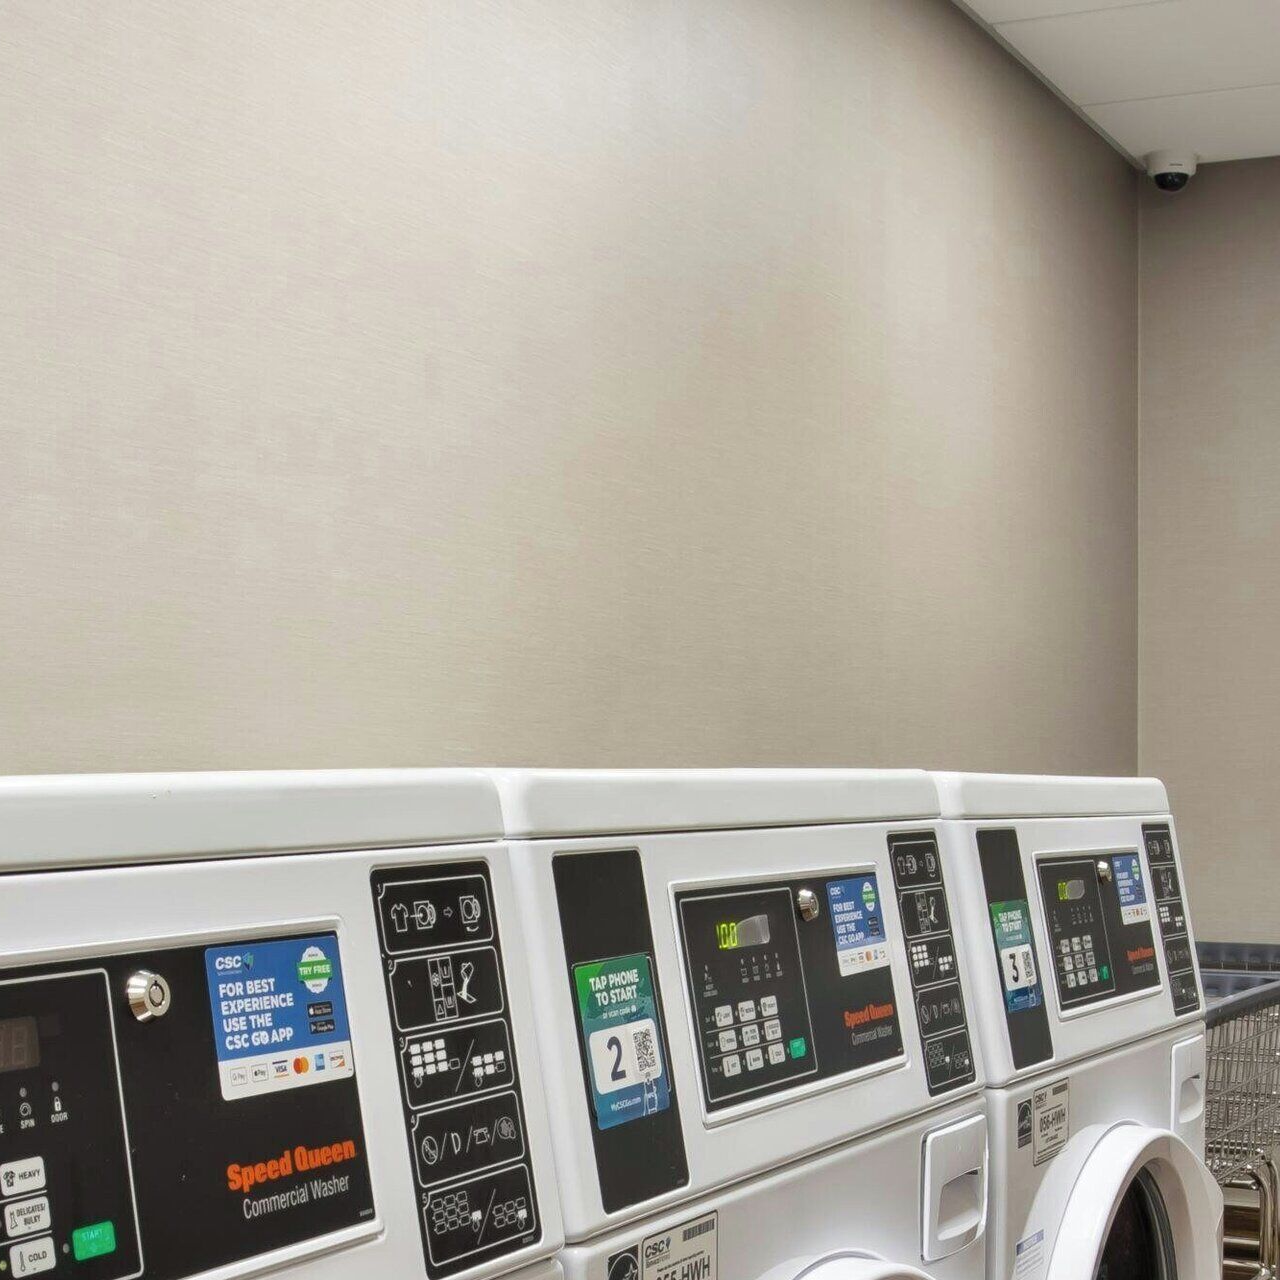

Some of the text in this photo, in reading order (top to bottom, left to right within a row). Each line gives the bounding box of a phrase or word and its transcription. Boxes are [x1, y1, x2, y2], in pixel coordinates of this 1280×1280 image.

[214, 955, 242, 970] CSC
[299, 963, 330, 975] TRY FREE
[1009, 952, 1019, 983] 3
[218, 977, 275, 998] FOR BEST
[588, 968, 639, 991] TAP PHONE
[220, 992, 294, 1015] EXPERIENCE
[595, 984, 637, 1006] TO START
[222, 1012, 273, 1033] USE THE
[843, 1006, 870, 1029] Speed
[224, 1033, 249, 1050] CSC
[270, 1026, 293, 1043] APP
[605, 1035, 626, 1081] 2
[19, 1118, 35, 1129] SPIN
[17, 1168, 40, 1180] HEAVY
[226, 1140, 355, 1192] Speed Queen
[242, 1175, 349, 1219] Commercial Washer
[27, 1249, 47, 1263] COLD
[645, 1239, 664, 1258] CSC
